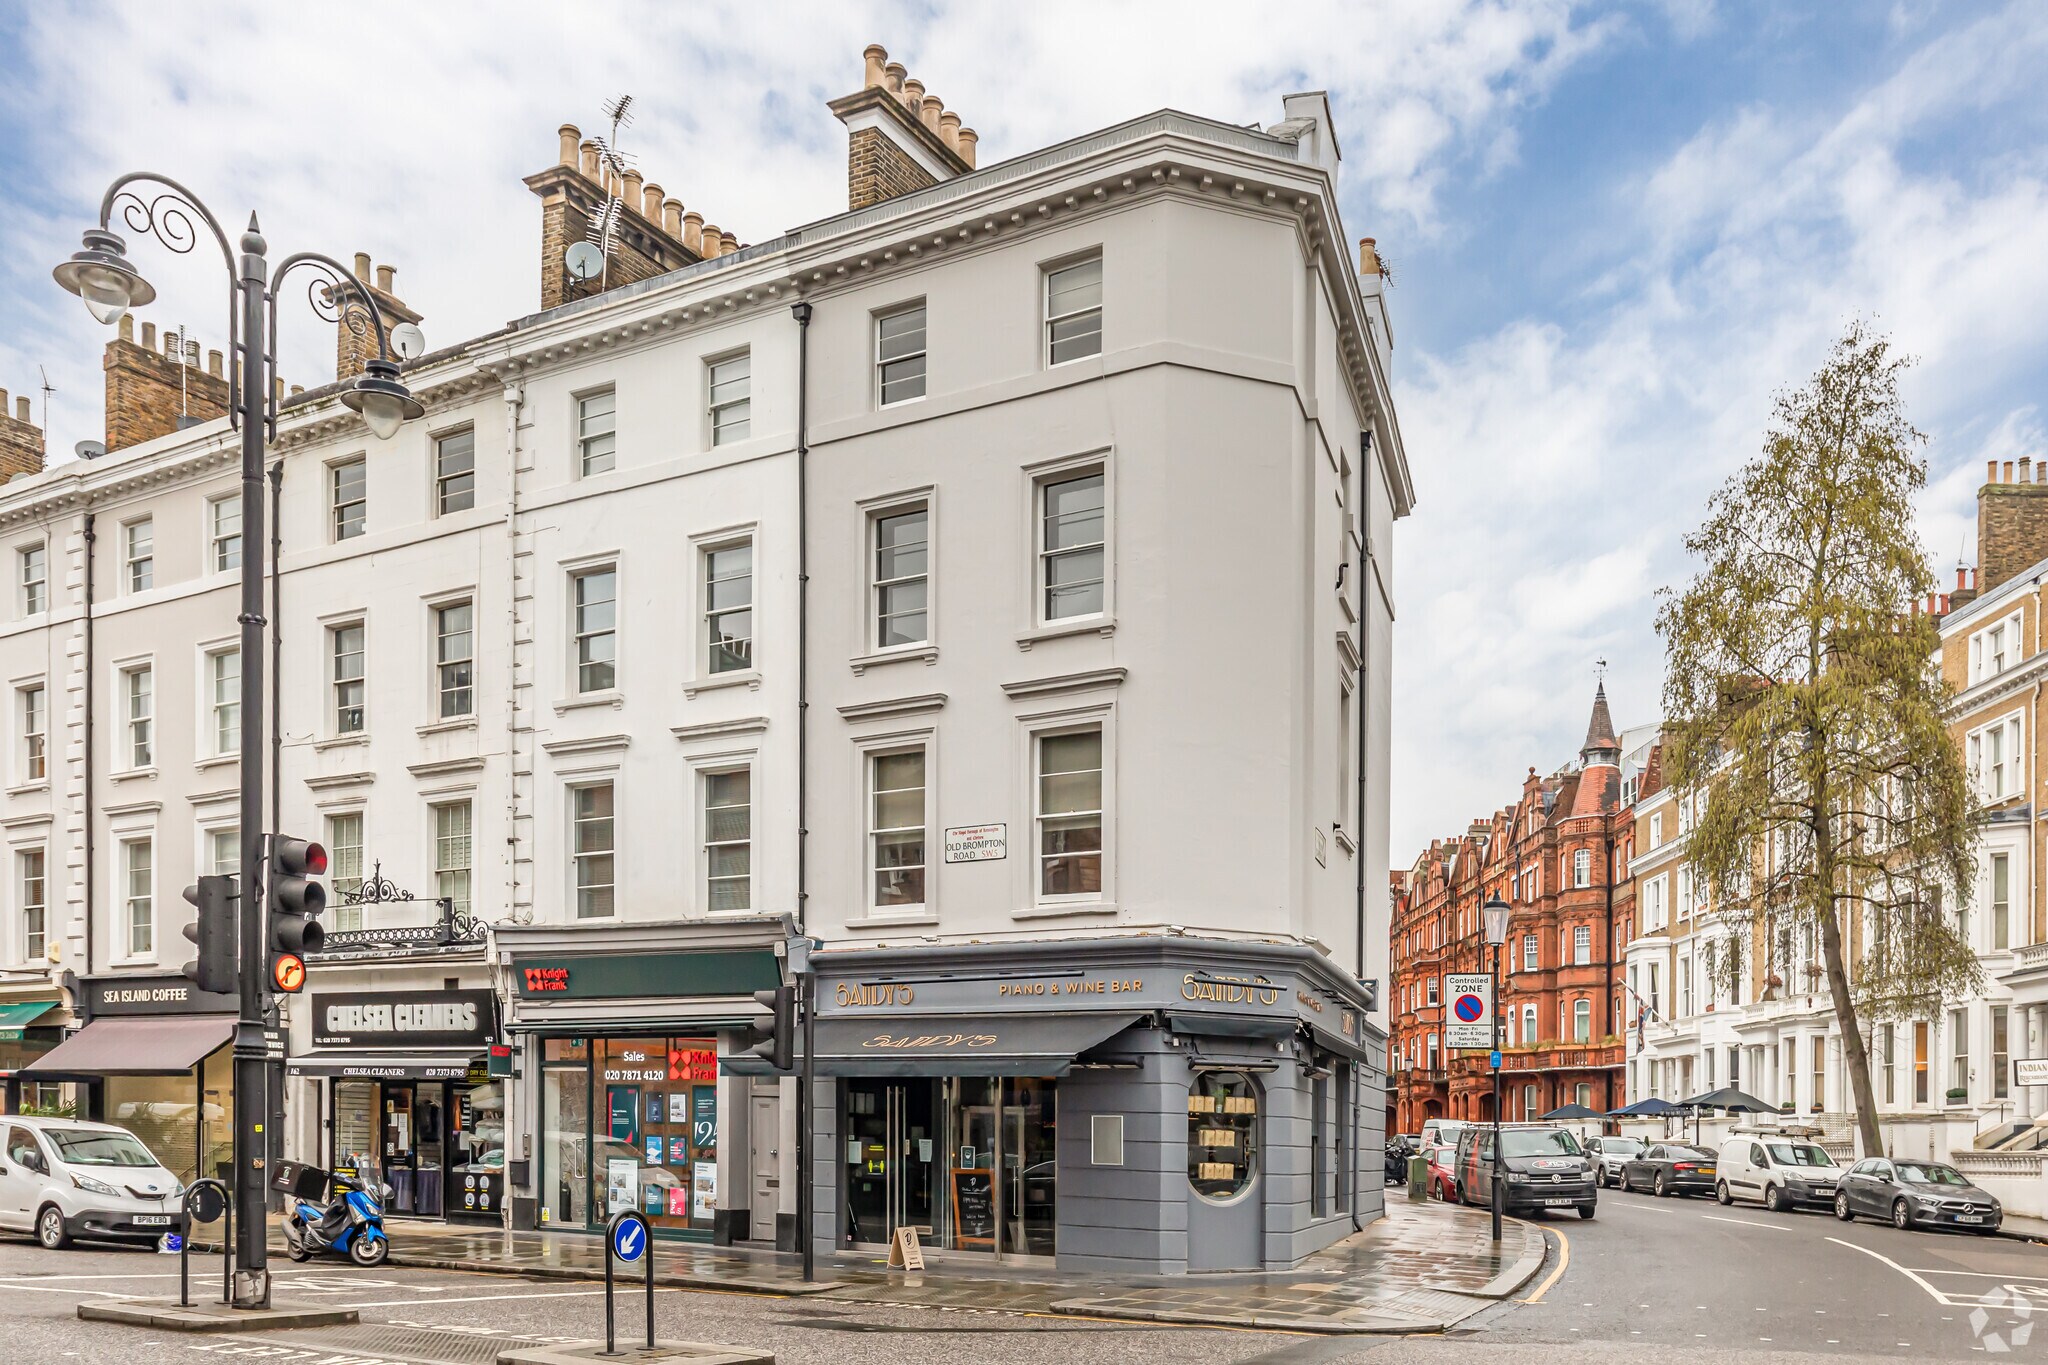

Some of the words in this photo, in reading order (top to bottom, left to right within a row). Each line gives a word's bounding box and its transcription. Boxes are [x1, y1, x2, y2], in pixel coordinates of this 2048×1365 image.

[946, 843, 961, 852] OLD
[963, 839, 1004, 850] BROMPTON
[541, 968, 569, 980] Knight
[543, 980, 568, 990] Frank
[1000, 983, 1045, 996] PIANO
[1050, 983, 1059, 994] &
[1065, 981, 1105, 994] WINE
[1111, 980, 1143, 992] BAR
[1455, 985, 1483, 993] ZONE
[103, 990, 119, 1003] SEA
[121, 989, 150, 1002] ISLAND
[152, 988, 187, 1001] COFFEE
[836, 982, 914, 1007] SANDY'S
[326, 1004, 394, 1032] CHELSEA
[394, 1002, 477, 1031] CLEANERS
[862, 1034, 997, 1048] SANDY'S
[623, 1051, 645, 1061] Sales
[693, 1051, 717, 1069] Knig
[290, 1067, 300, 1075] 162
[343, 1067, 371, 1076] CHELSEA
[371, 1067, 405, 1076] CLEANERS
[426, 1068, 436, 1076] 020
[437, 1068, 450, 1076] 7373
[450, 1068, 464, 1076] 8795
[693, 1067, 717, 1080] Fran
[2019, 1063, 2048, 1072] INDIAN
[605, 1070, 620, 1080] 020
[622, 1070, 641, 1080] 7871
[643, 1070, 664, 1080] 4120
[138, 1216, 152, 1224] BP16
[187, 1342, 319, 1360] LEFT
